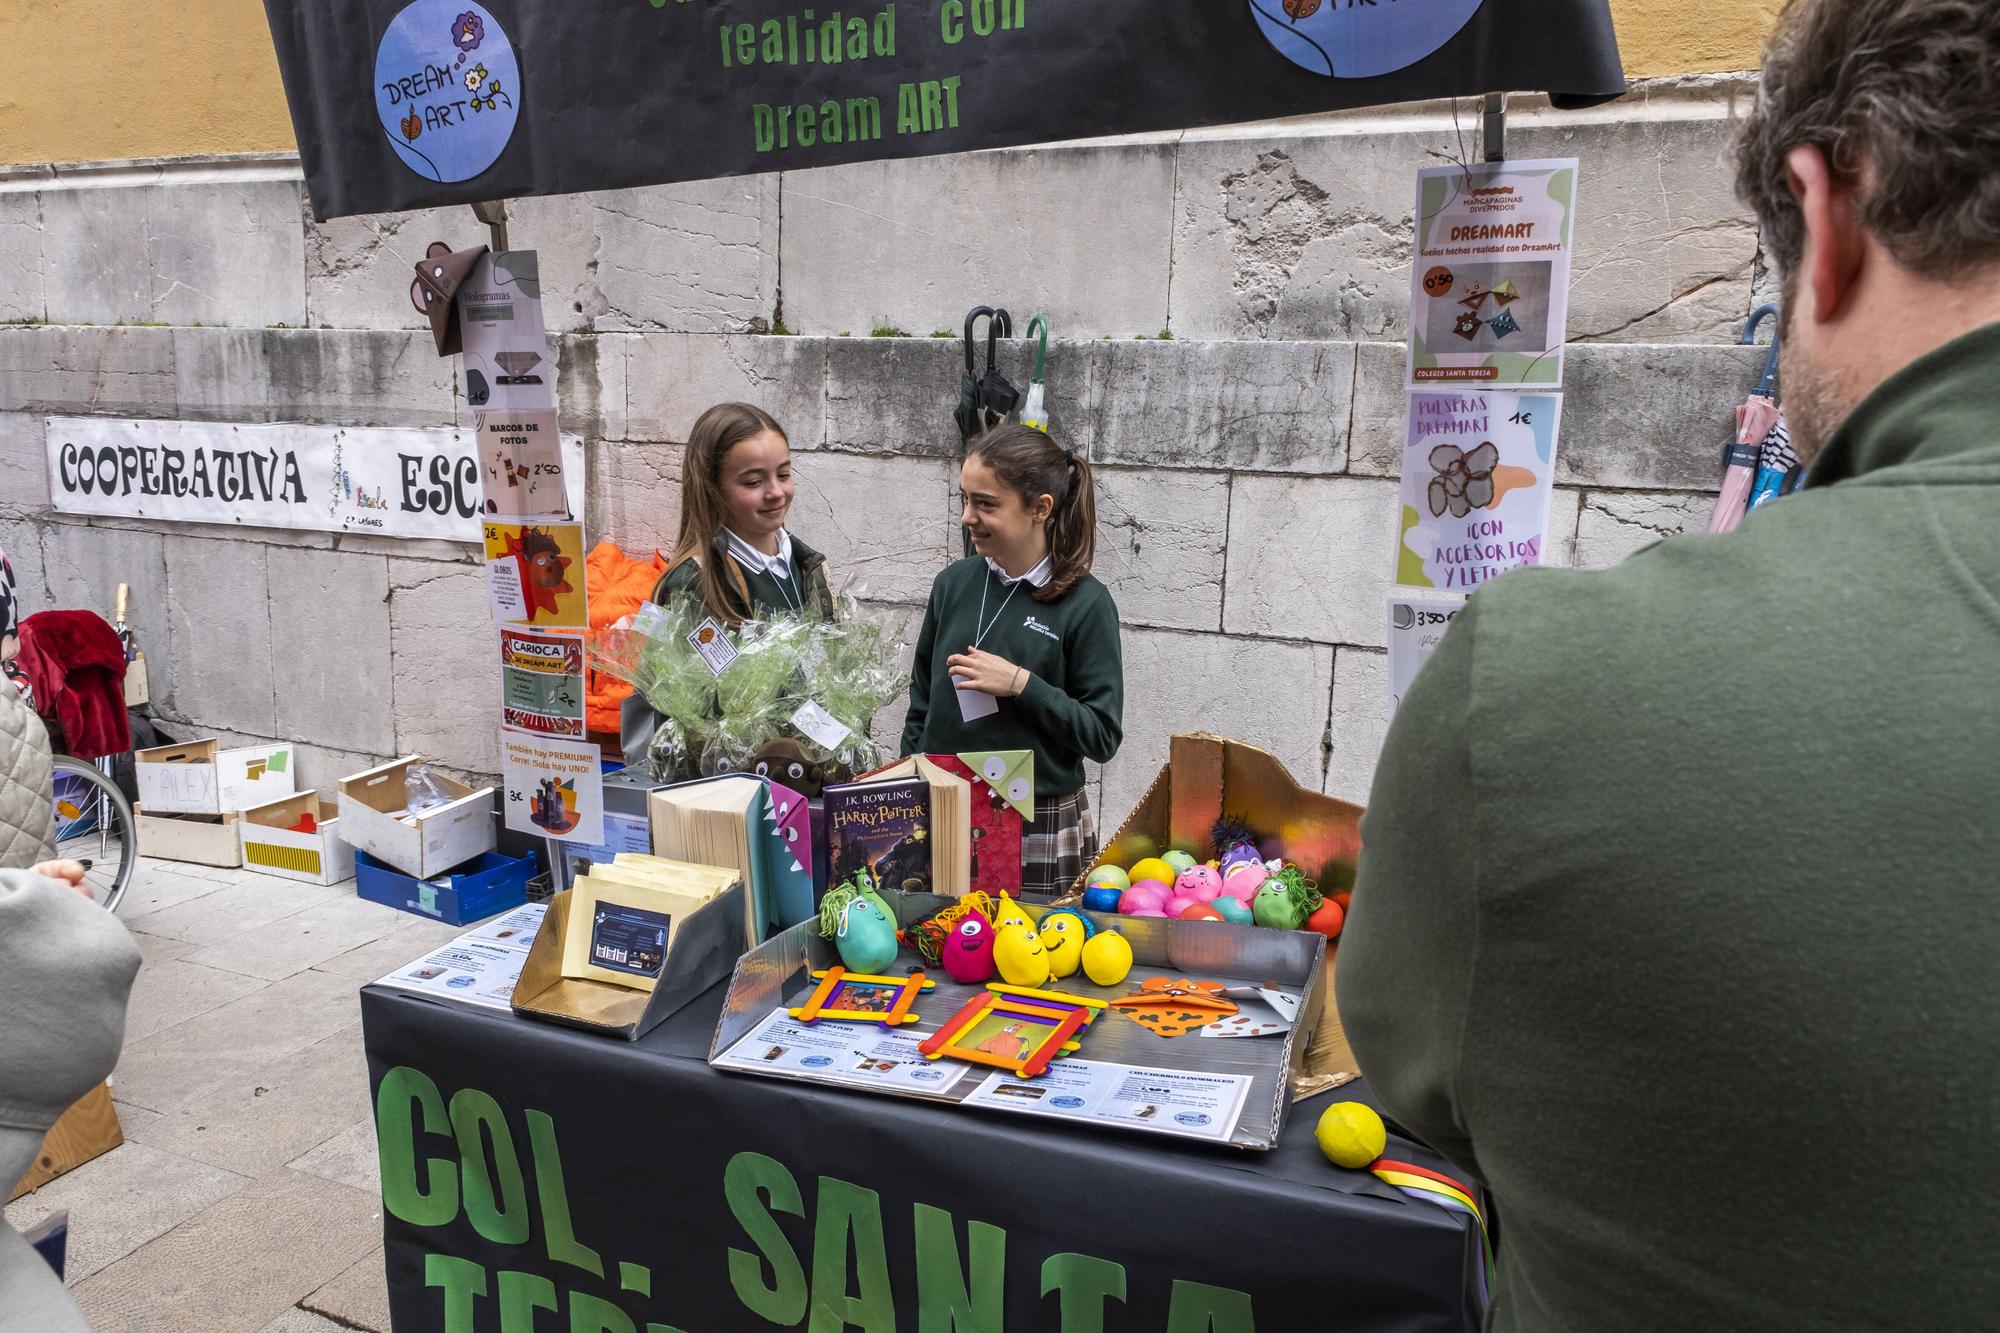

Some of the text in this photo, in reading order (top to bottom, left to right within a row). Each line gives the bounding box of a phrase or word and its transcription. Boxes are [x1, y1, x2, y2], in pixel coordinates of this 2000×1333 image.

[720, 0, 1025, 67] realidad con
[383, 64, 453, 104] DREAM
[426, 101, 467, 131] ART
[752, 75, 961, 152] Dream ART
[1451, 223, 1535, 242] DREAMART
[1445, 247, 1470, 255] hechos
[1472, 244, 1504, 254] realidad
[1506, 244, 1519, 252] con
[1521, 242, 1561, 252] DreamArt
[464, 291, 511, 303] Hologramas
[1417, 369, 1491, 378] COLEGIO SANTA TERESA
[1419, 396, 1487, 416] PULSERAS
[490, 424, 523, 432] MARCOS
[1417, 416, 1490, 435] DREAMART
[1508, 412, 1532, 425] 1€
[60, 443, 307, 503] COOPERATIVA
[398, 452, 479, 518] ESC
[485, 527, 498, 540] 2€
[1436, 538, 1538, 564] ACCESORIOS
[1444, 567, 1455, 588] Y
[513, 641, 561, 656] CARIOCA
[559, 692, 576, 708] 2€
[506, 743, 533, 755] También
[534, 748, 547, 759] hay
[552, 762, 566, 773] hay
[569, 765, 589, 774] UNO!
[160, 768, 213, 802] ALEX
[863, 790, 912, 804] ROWLING
[377, 1066, 651, 1298] COL.
